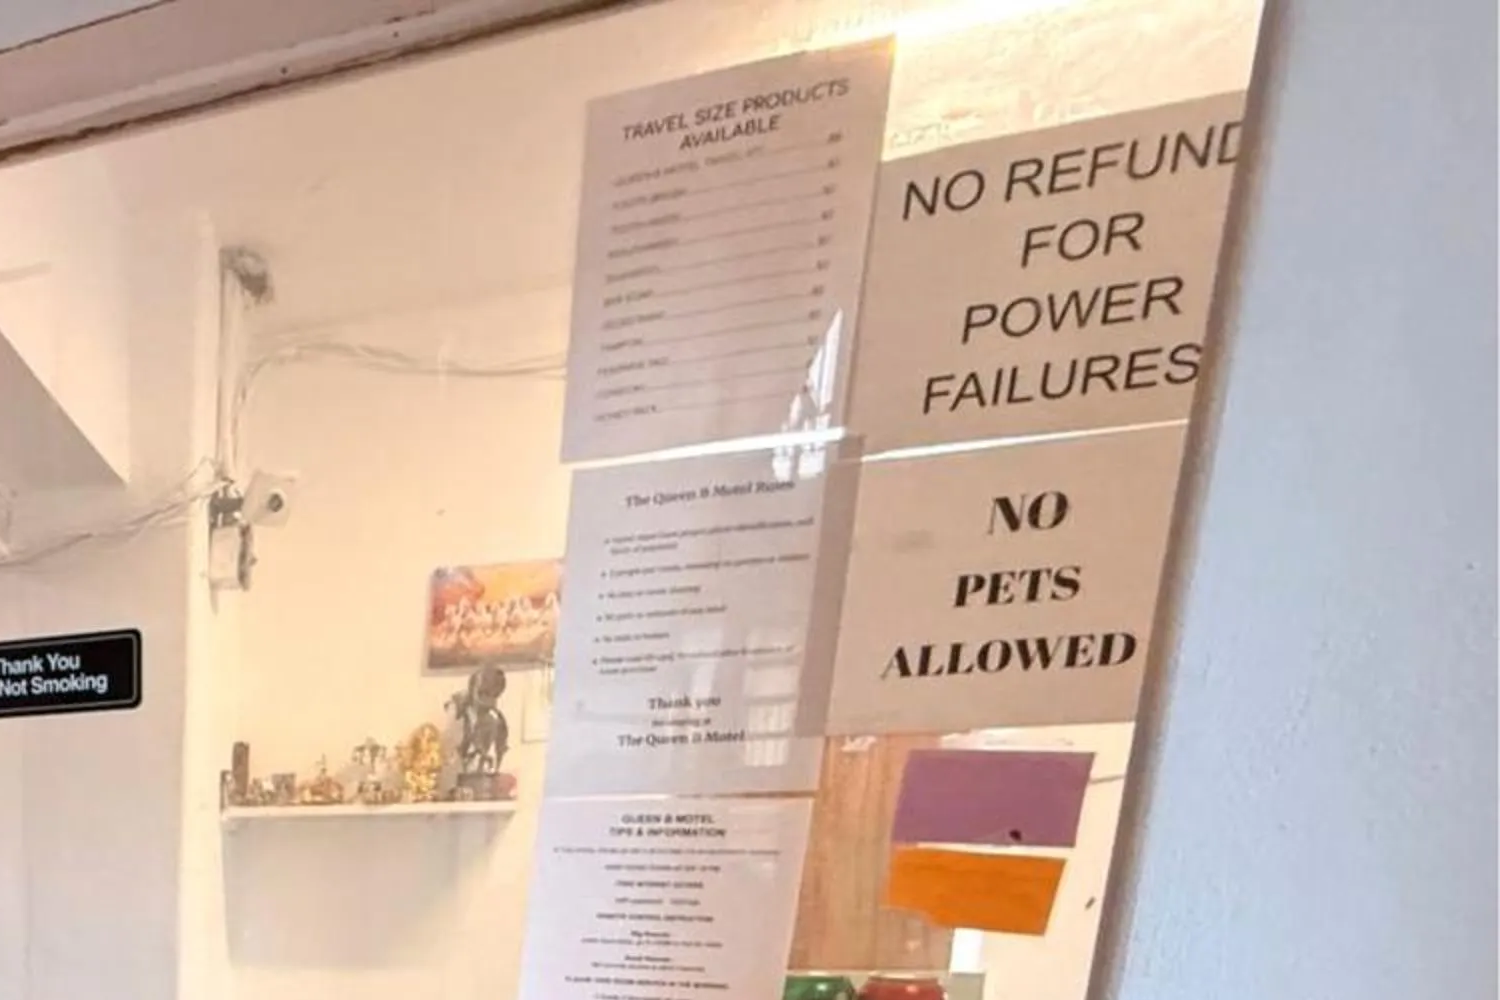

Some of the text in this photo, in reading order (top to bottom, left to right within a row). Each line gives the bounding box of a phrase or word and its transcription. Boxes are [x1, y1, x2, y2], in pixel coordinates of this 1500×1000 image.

[622, 78, 850, 141] TRAVEL SIZE PRODUCTS
[679, 113, 782, 150] AVAILABLE
[901, 170, 985, 221] NO
[1020, 212, 1146, 268] FOR
[961, 275, 1184, 345] POWER
[921, 342, 1204, 415] FAILURES
[625, 494, 651, 508] The
[986, 490, 1070, 535] NO
[953, 565, 1082, 608] PETS
[45, 652, 81, 672] You
[879, 631, 1138, 679] ALLOWED
[30, 672, 109, 696] Smoking
[675, 814, 715, 825] MOTEL
